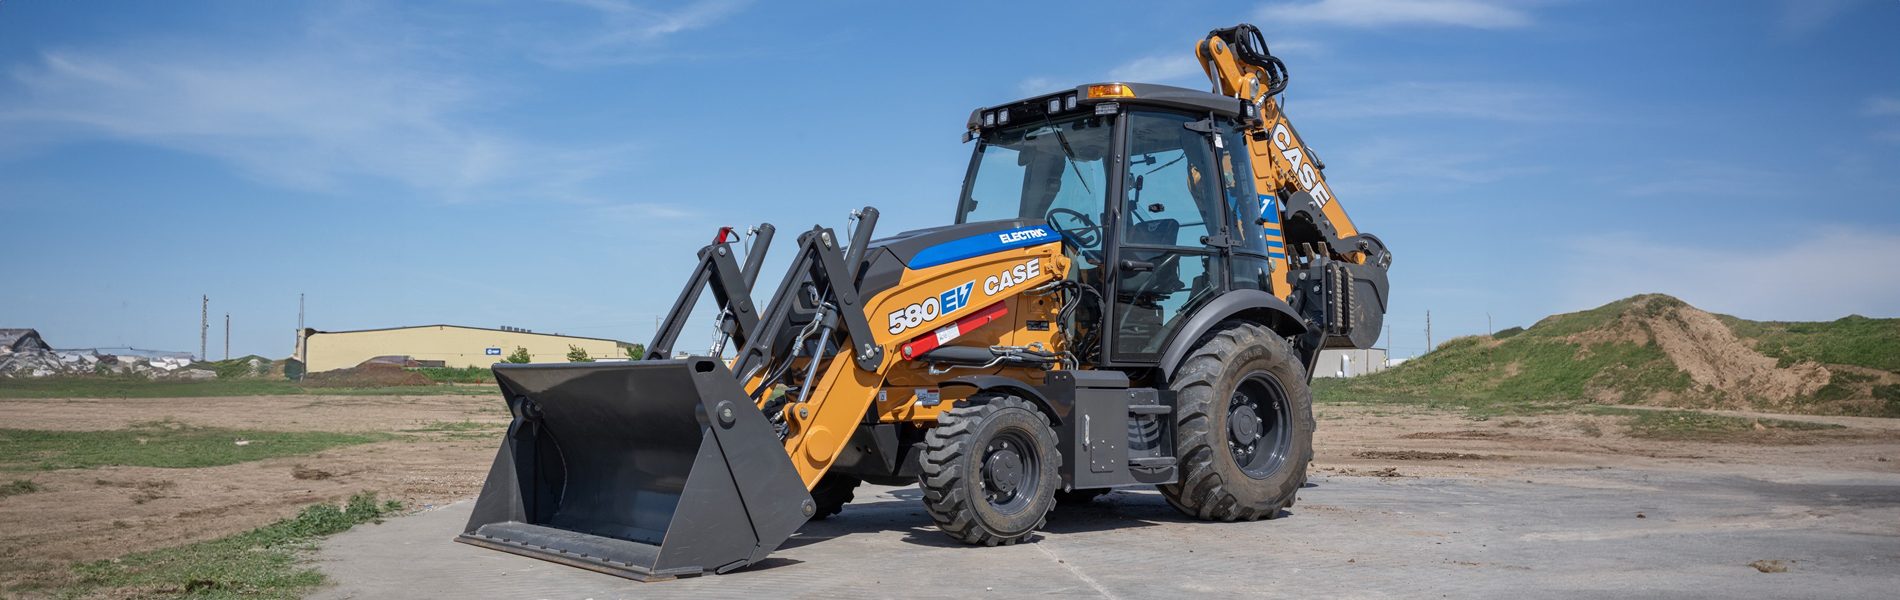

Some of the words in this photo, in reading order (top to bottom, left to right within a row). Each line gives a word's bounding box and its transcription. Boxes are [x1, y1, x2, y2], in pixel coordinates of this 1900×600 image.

[1273, 123, 1331, 208] CASE
[999, 228, 1047, 244] ELECTRIC
[983, 257, 1040, 296] CASE
